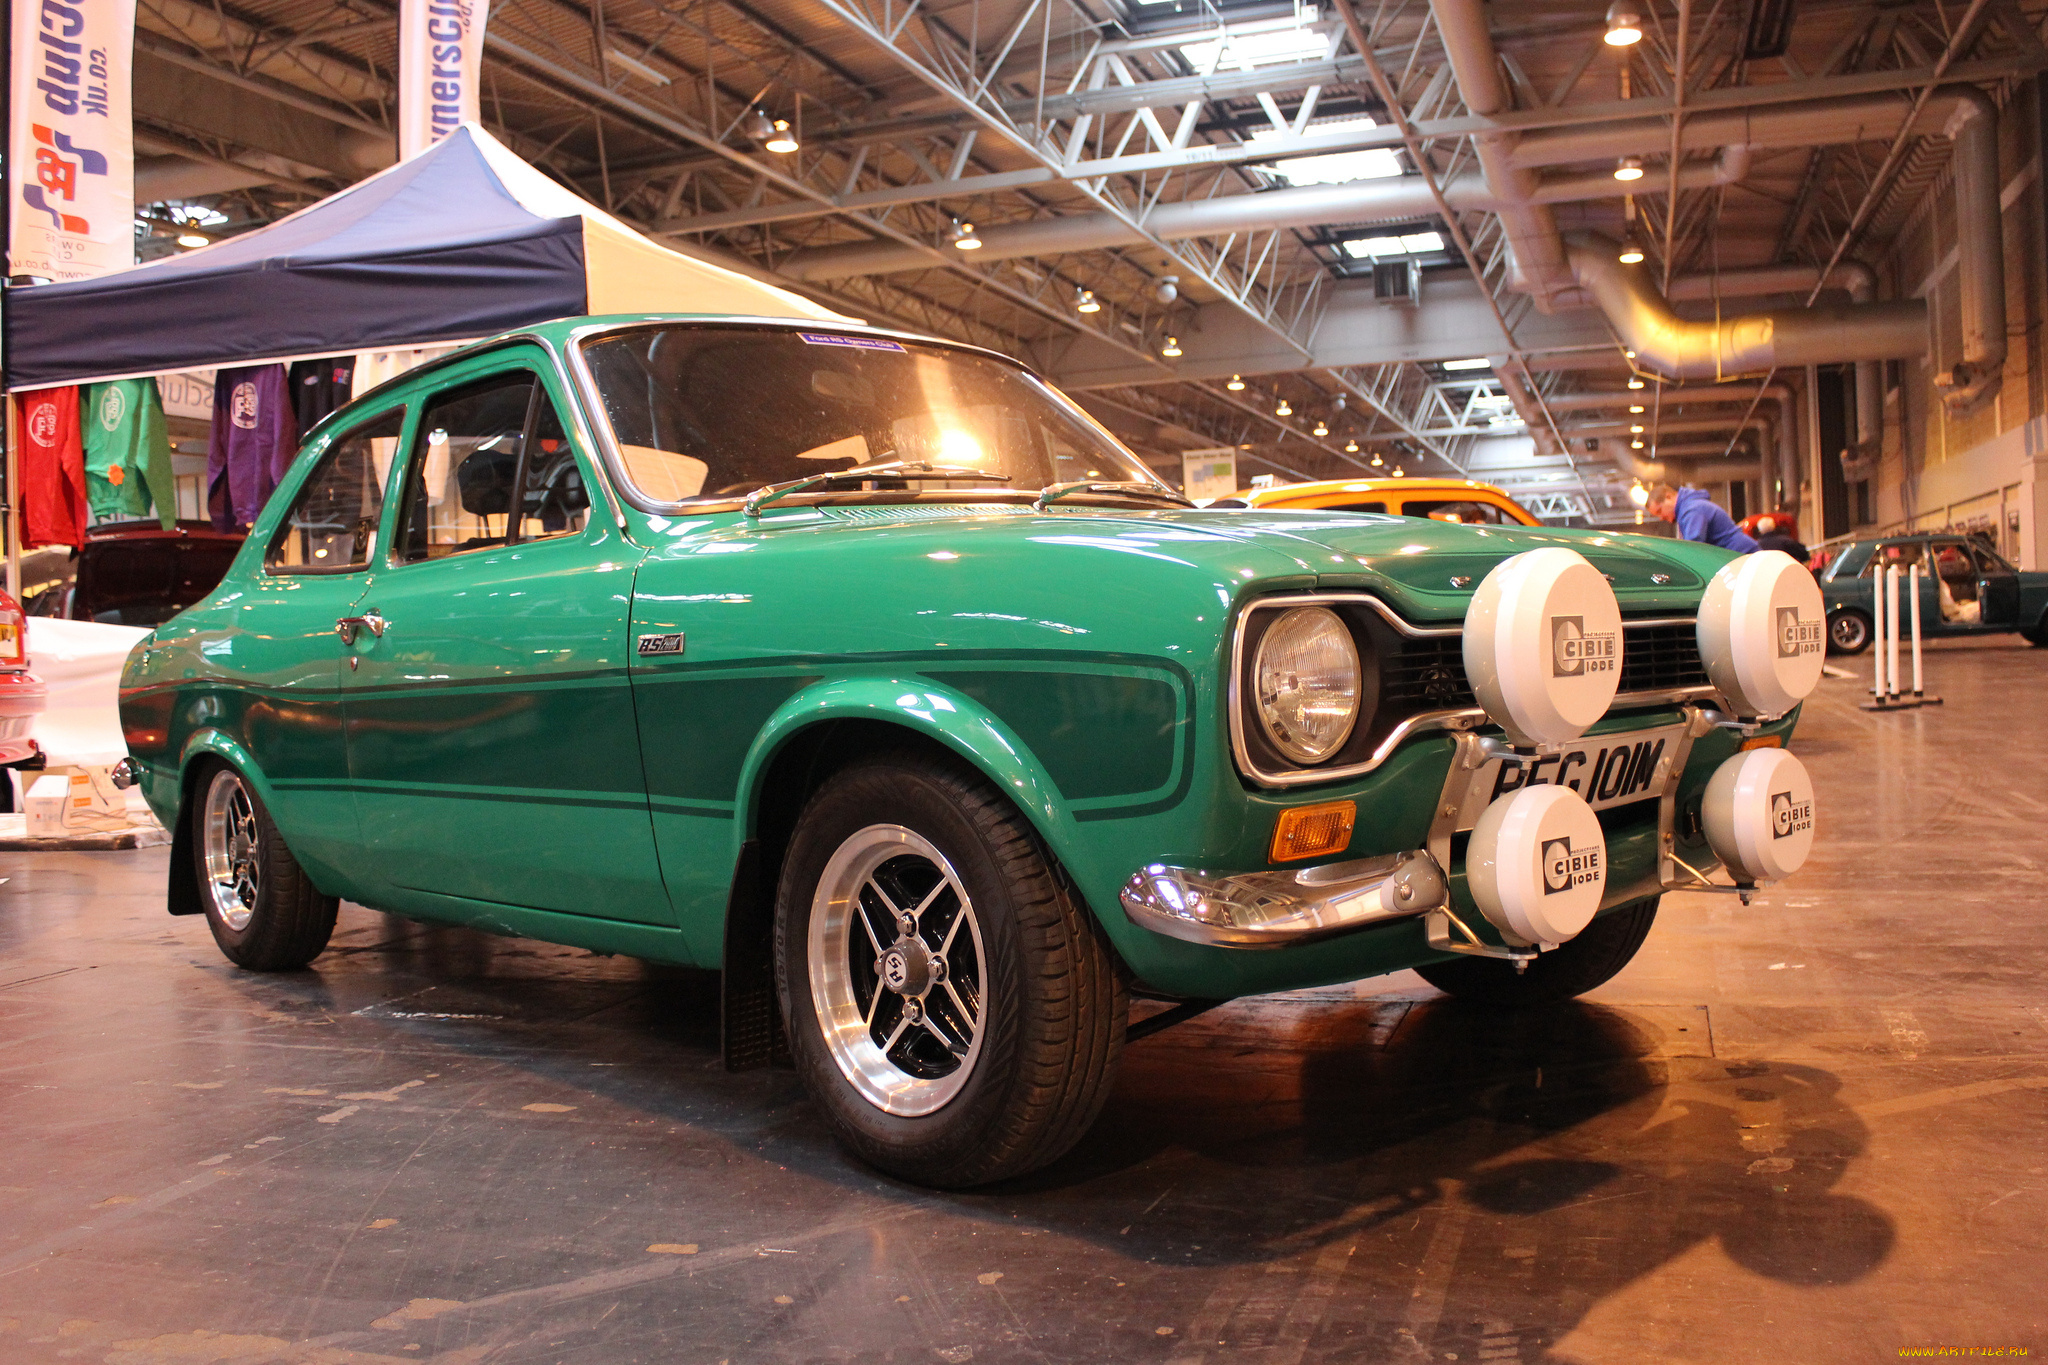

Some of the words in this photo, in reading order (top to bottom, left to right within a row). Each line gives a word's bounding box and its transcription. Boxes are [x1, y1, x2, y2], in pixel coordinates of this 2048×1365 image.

[875, 340, 895, 348] Club
[1785, 627, 1820, 641] CIBIE
[1565, 640, 1614, 657] CIBIE
[1800, 643, 1820, 654] IODE
[1586, 660, 1614, 672] IODE
[1780, 805, 1810, 823] CIBIE
[1793, 820, 1811, 832] IODE
[1554, 853, 1598, 875] CIBIE
[1573, 871, 1600, 886] IODE
